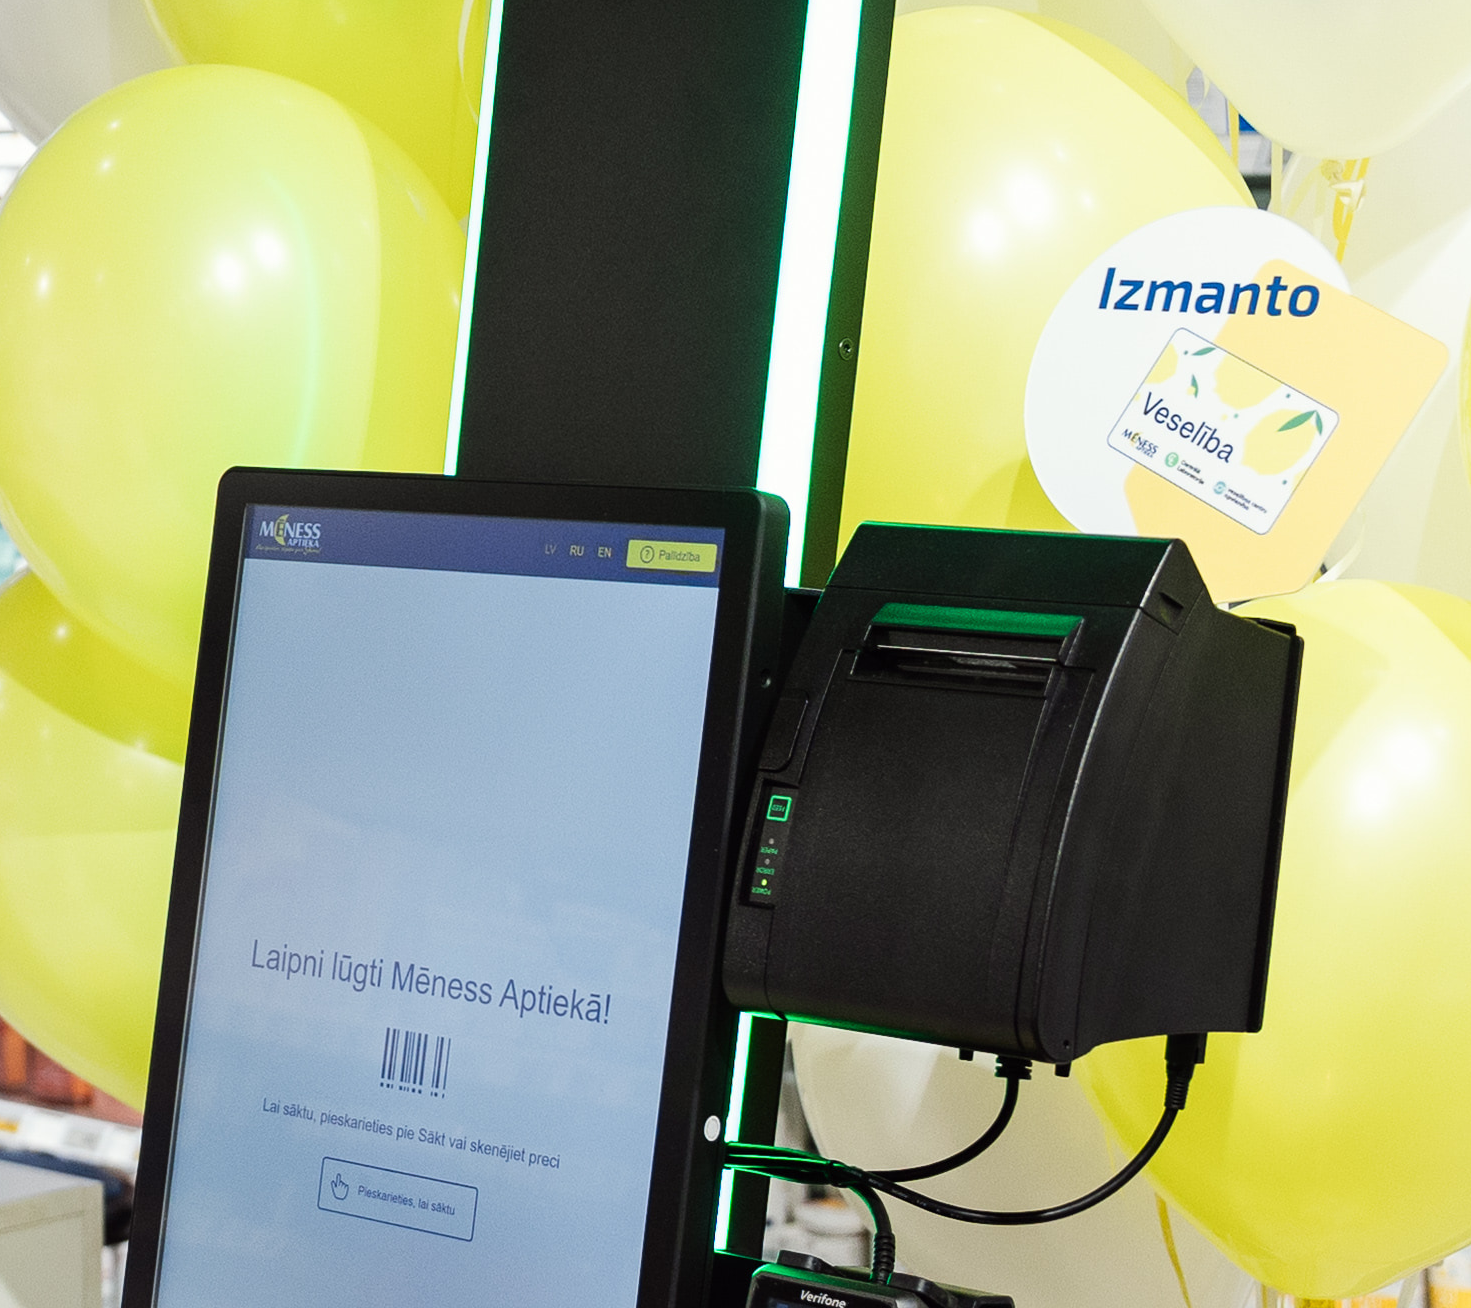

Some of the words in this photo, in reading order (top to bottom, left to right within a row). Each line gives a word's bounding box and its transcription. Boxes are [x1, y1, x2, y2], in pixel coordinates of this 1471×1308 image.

[1099, 267, 1321, 318] Izmanto
[1142, 391, 1234, 464] Veselība
[259, 517, 322, 540] MĒNESS
[544, 544, 557, 555] LV
[569, 544, 585, 558] RU
[597, 546, 612, 559] EN
[755, 866, 775, 876] ERROR
[751, 886, 771, 896] POWER
[251, 938, 325, 981] Laipni
[331, 951, 384, 993] lūgti
[391, 960, 493, 1005] Mēness
[499, 978, 612, 1025] Aptiekā!
[262, 1096, 280, 1114] Lai
[282, 1101, 317, 1124] sāktu,
[320, 1108, 394, 1136] pieskarieties
[396, 1124, 415, 1141] pie
[418, 1126, 446, 1148] Sākt
[448, 1135, 467, 1151] vai
[469, 1138, 526, 1163] skenējiet
[528, 1149, 561, 1170] preci
[357, 1184, 417, 1209] Pieskarieties,
[417, 1198, 430, 1212] lai
[431, 1200, 456, 1217] sāktu
